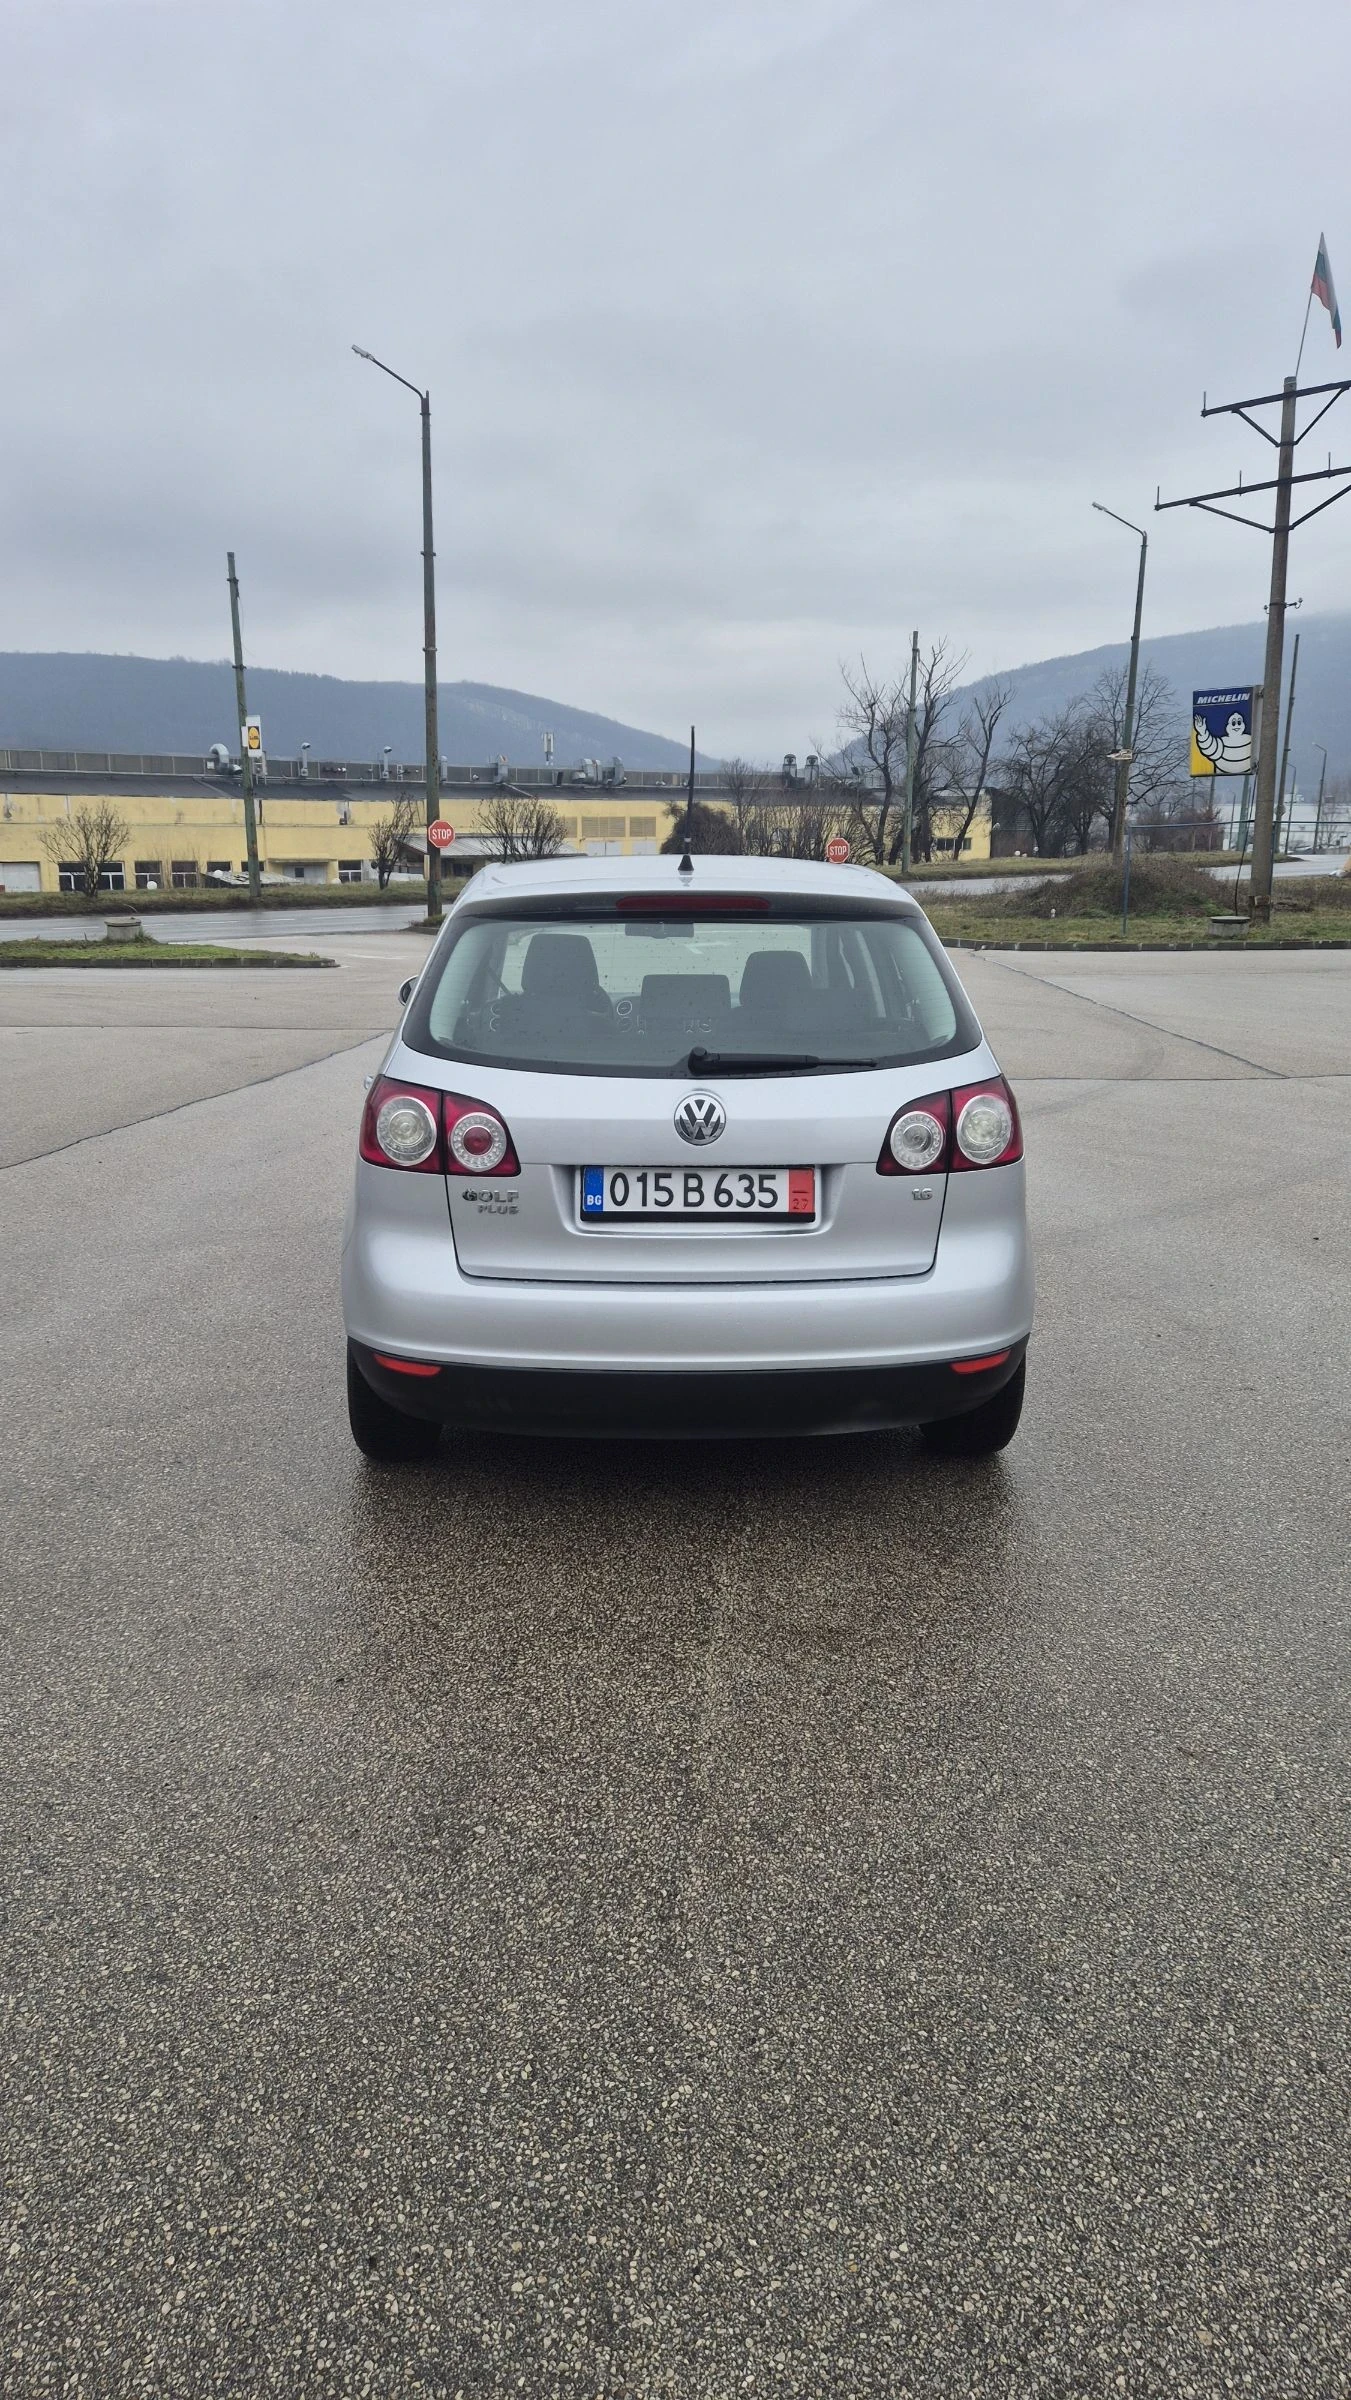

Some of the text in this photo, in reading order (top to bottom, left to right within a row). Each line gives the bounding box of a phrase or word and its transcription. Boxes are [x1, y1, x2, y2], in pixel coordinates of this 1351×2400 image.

[1197, 693, 1250, 704] MICHELIN
[432, 828, 452, 840] STOP
[829, 845, 847, 856] STOP
[461, 1189, 519, 1203] GOLF
[586, 1194, 602, 1206] BG
[477, 1203, 519, 1214] PLUS
[792, 1198, 809, 1210] 27
